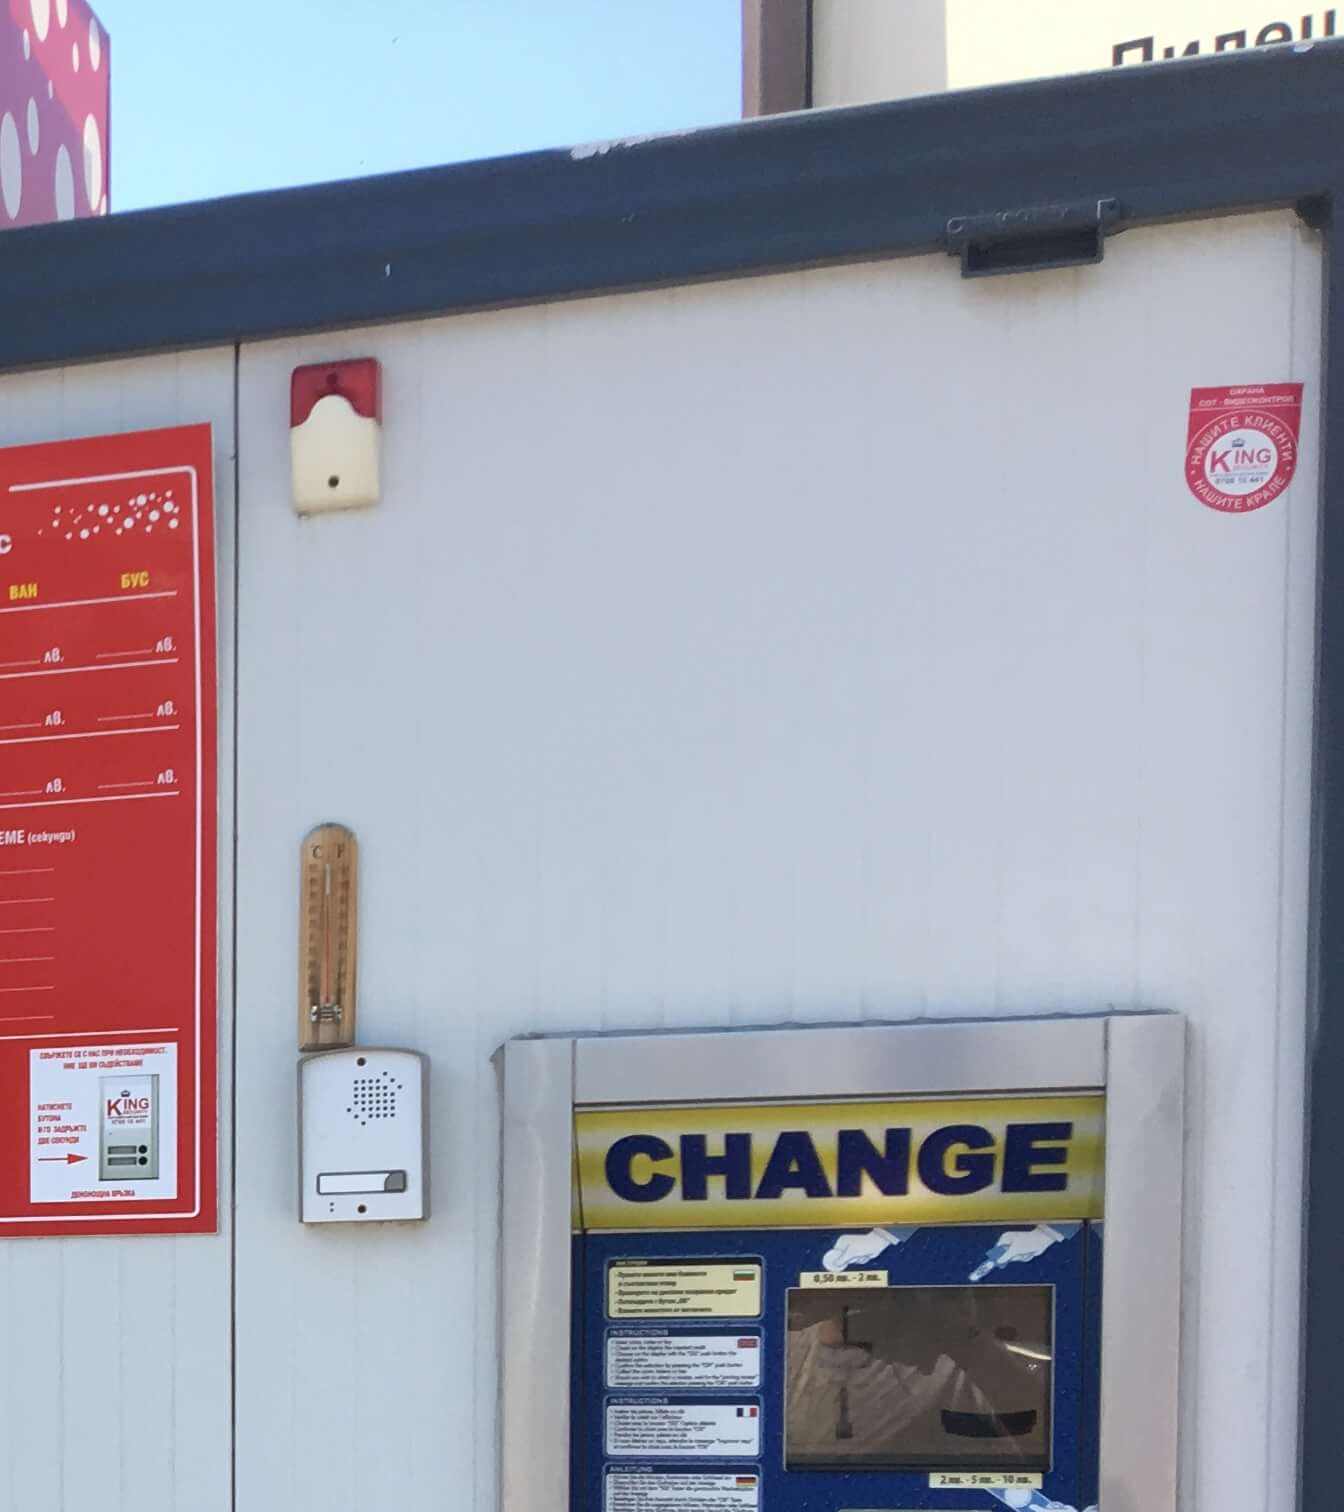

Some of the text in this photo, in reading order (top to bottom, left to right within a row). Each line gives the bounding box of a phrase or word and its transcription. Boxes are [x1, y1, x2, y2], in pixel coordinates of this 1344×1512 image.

[1191, 415, 1294, 465] НАШИТЕ КЛИЕНТИ
[1209, 448, 1272, 473] KING
[1194, 476, 1286, 509] НАШИТЕ КРАЛЕ
[9, 583, 39, 601] ВАН
[121, 571, 150, 589] БУС
[107, 1097, 150, 1116] KING
[604, 1121, 1074, 1203] CHANGE
